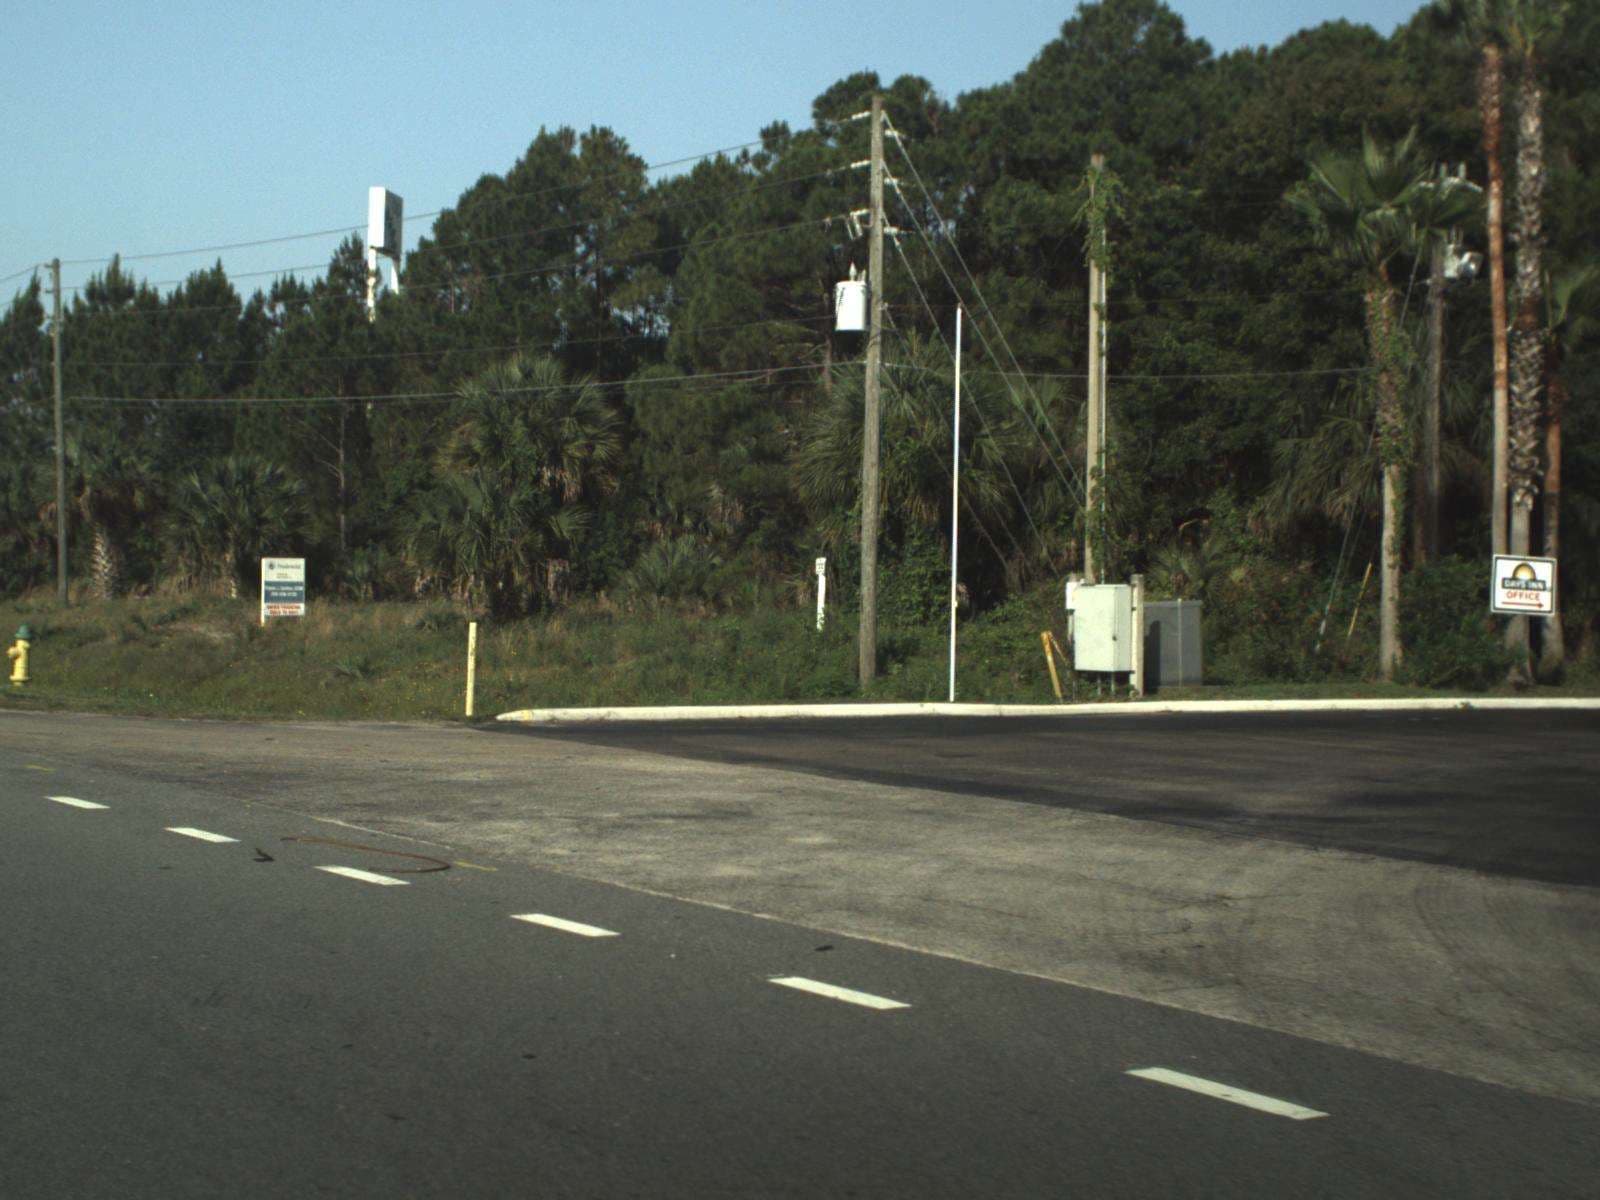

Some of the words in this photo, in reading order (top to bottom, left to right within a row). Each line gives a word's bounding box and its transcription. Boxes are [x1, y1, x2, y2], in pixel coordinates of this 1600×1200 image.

[1504, 579, 1526, 589] DAYS
[1528, 581, 1544, 590] INN
[1506, 591, 1541, 601] OFFICE
